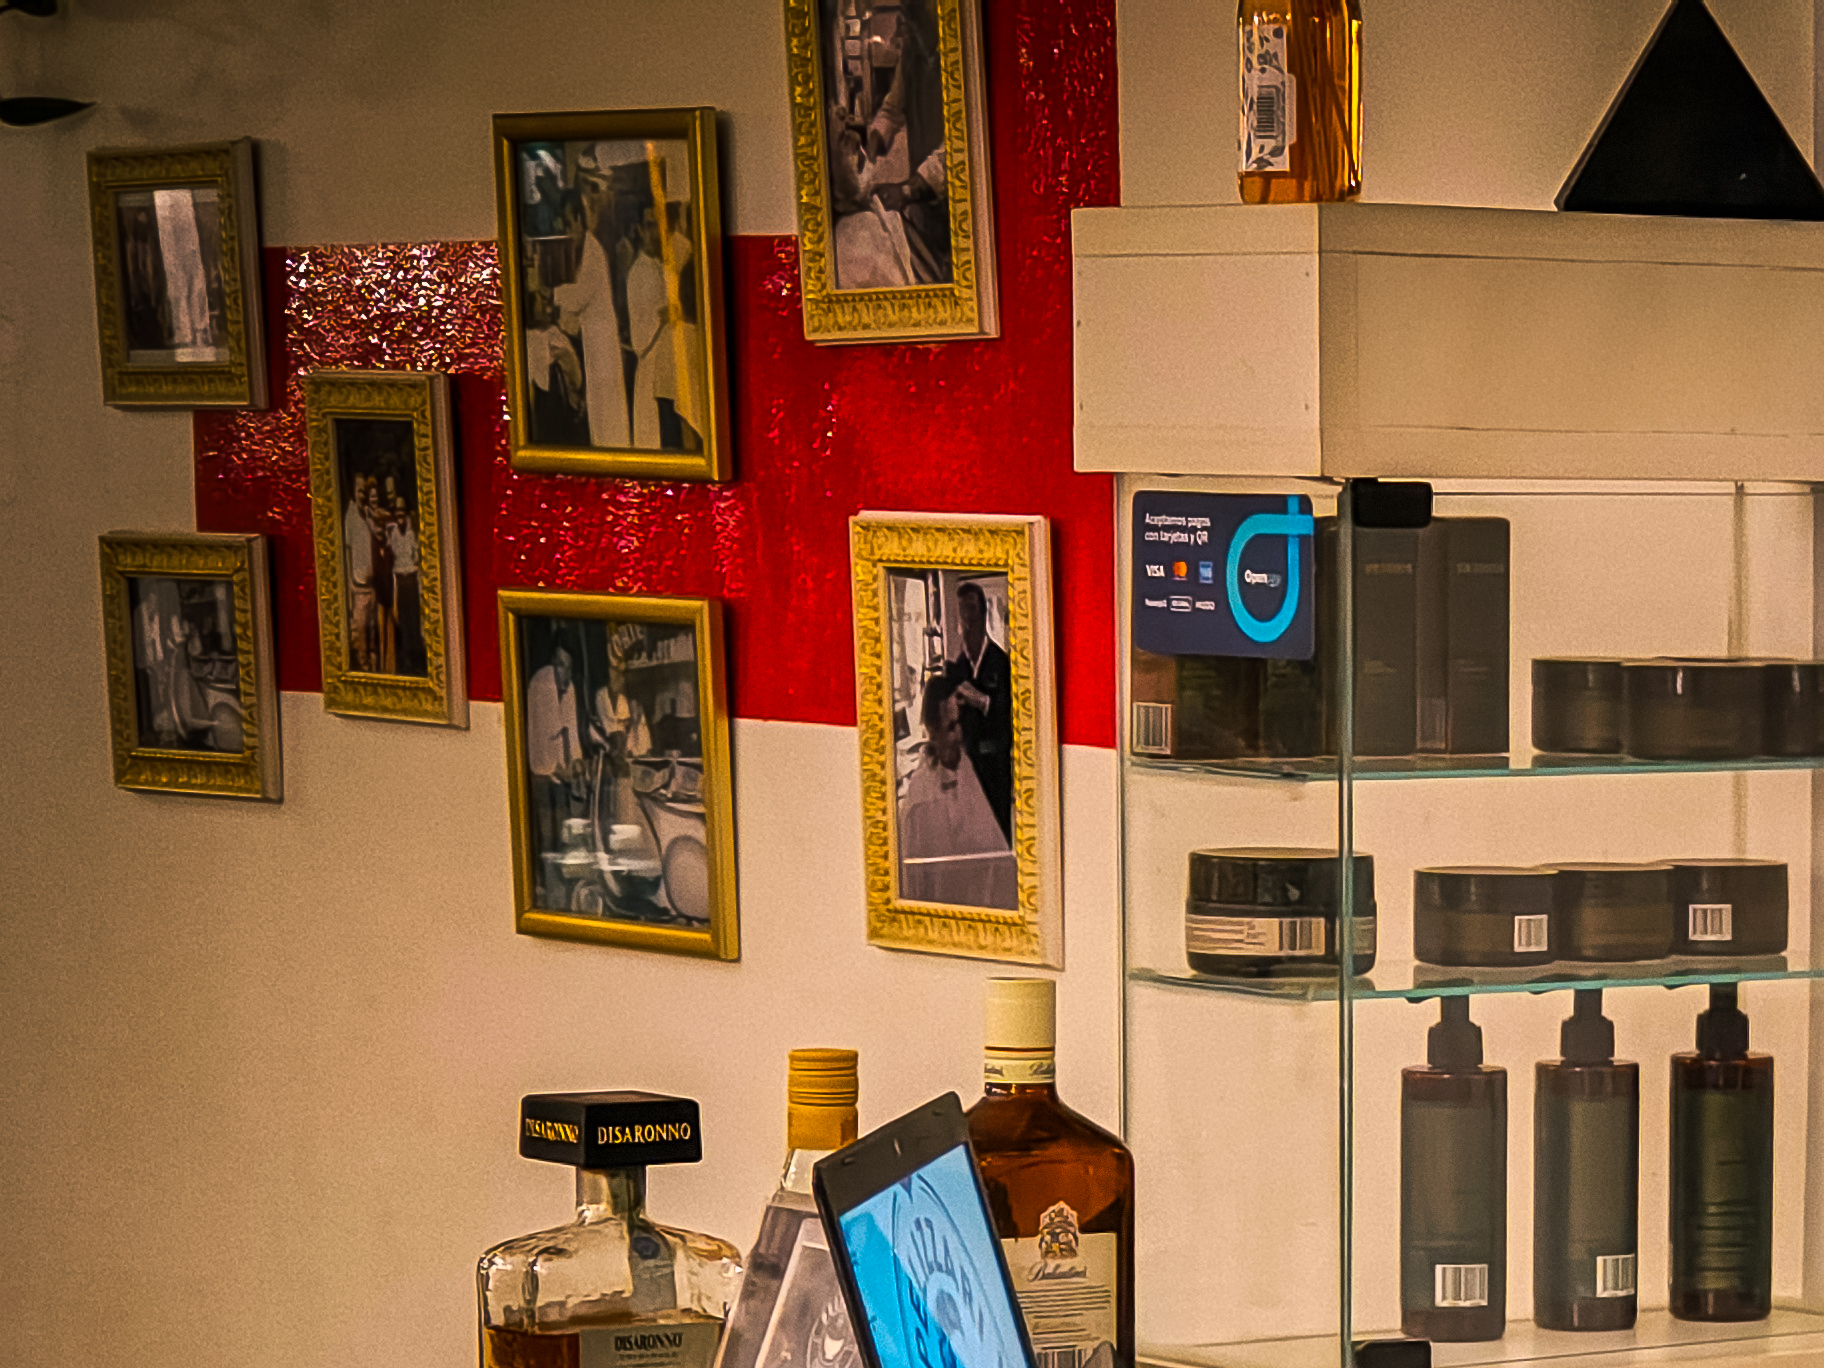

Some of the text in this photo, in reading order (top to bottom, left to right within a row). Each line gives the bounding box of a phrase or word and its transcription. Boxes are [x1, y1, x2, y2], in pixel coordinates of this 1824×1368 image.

[1145, 564, 1166, 577] VISA
[598, 1122, 692, 1145] DISARONNO
[614, 1332, 684, 1352] DISARONNO
